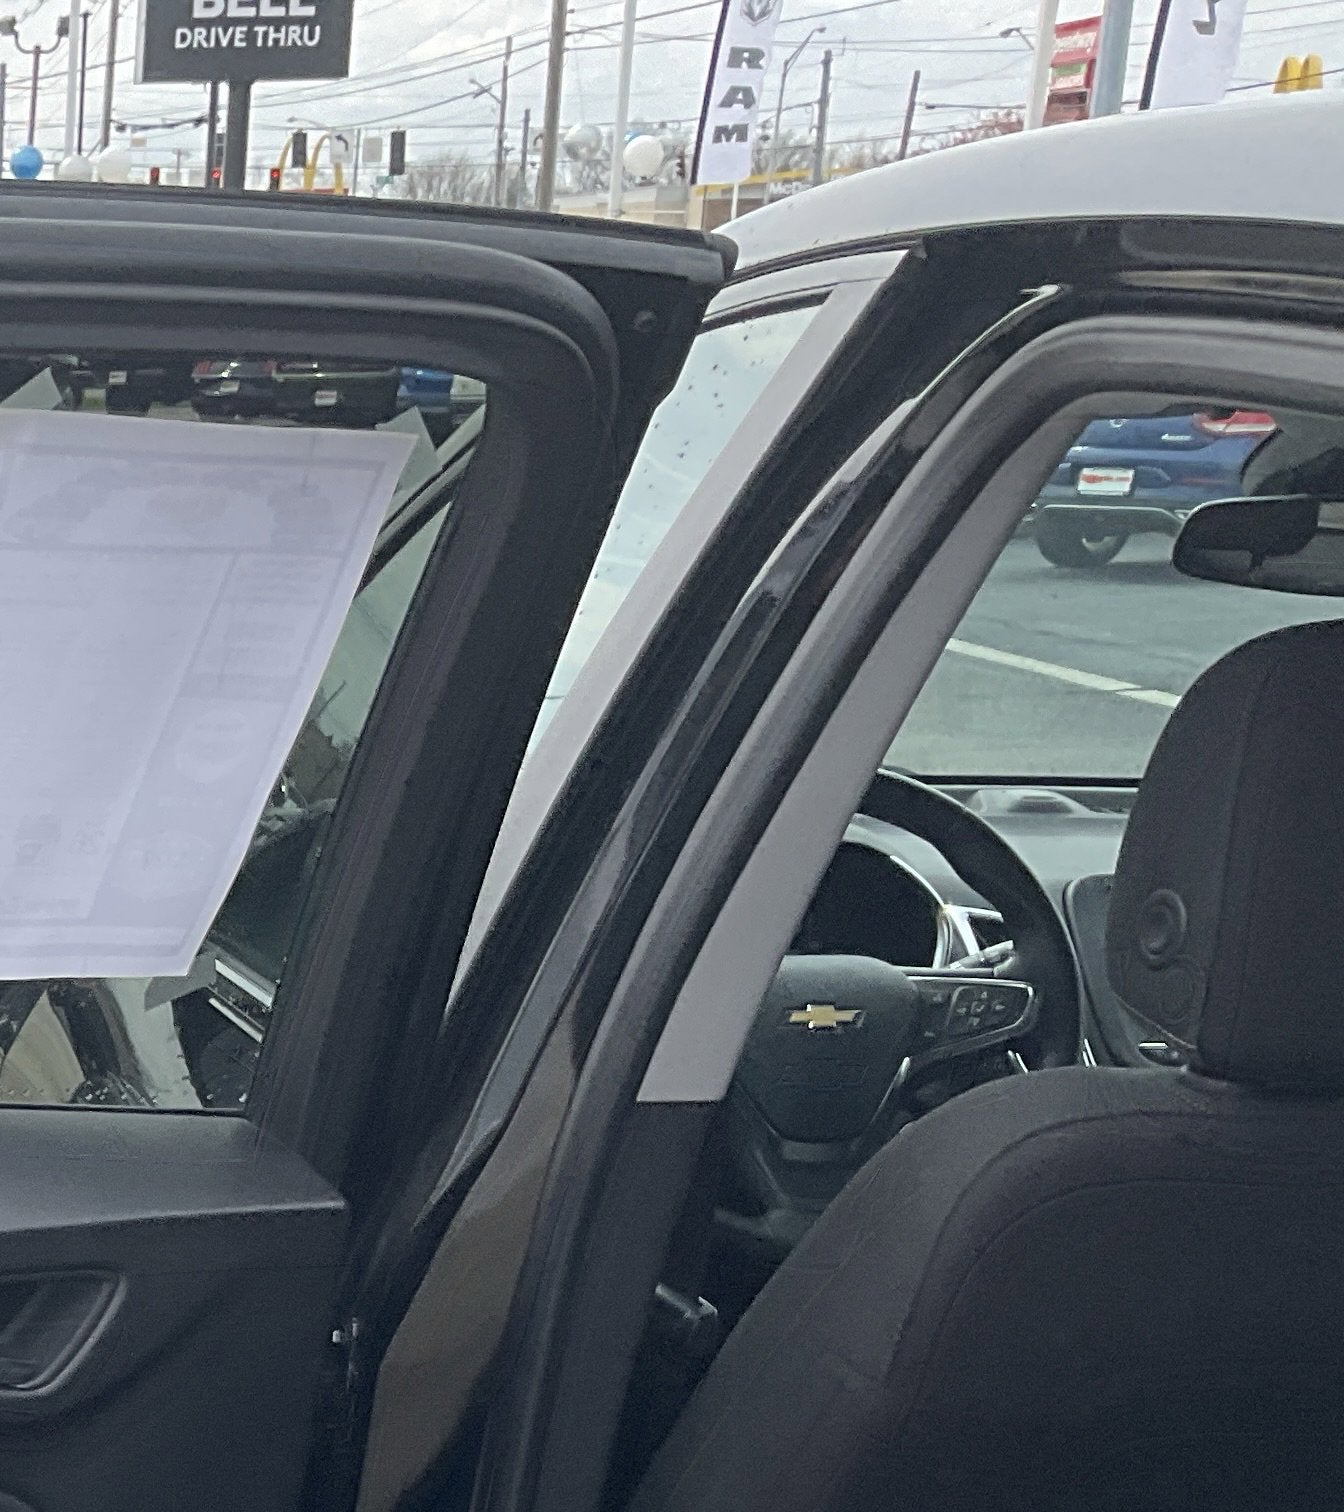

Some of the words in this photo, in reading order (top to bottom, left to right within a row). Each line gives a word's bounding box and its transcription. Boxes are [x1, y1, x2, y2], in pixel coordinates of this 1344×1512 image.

[174, 26, 248, 49] DRIVE
[254, 25, 321, 47] THRU
[713, 46, 766, 144] RAM
